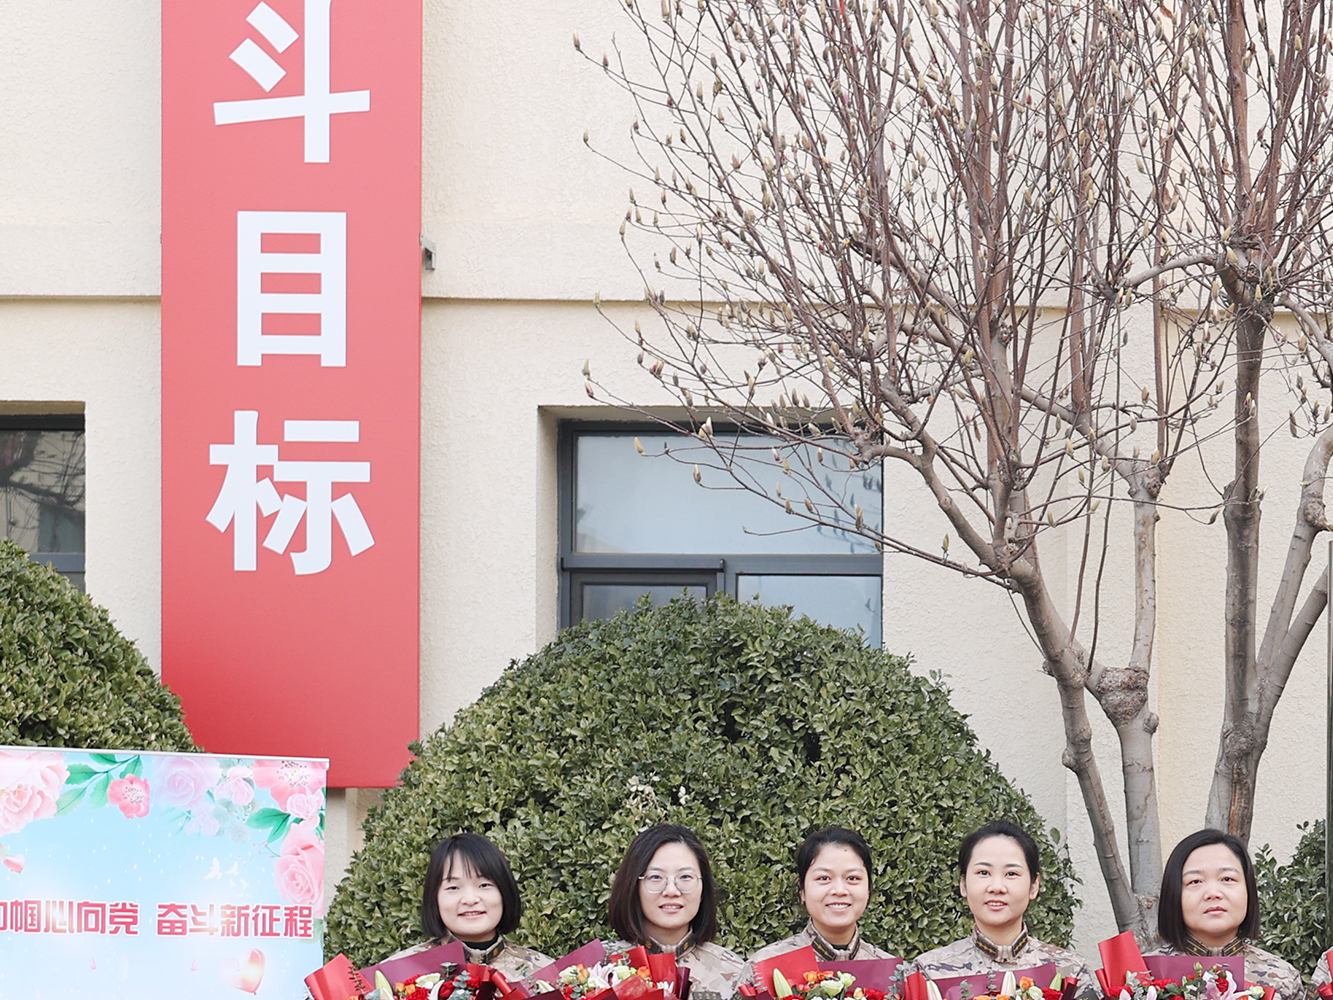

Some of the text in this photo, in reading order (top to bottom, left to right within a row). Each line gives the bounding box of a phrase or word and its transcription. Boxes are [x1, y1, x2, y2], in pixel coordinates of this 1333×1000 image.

[206, 0, 375, 575] 斗目标
[156, 903, 315, 938] 奋斗新征程
